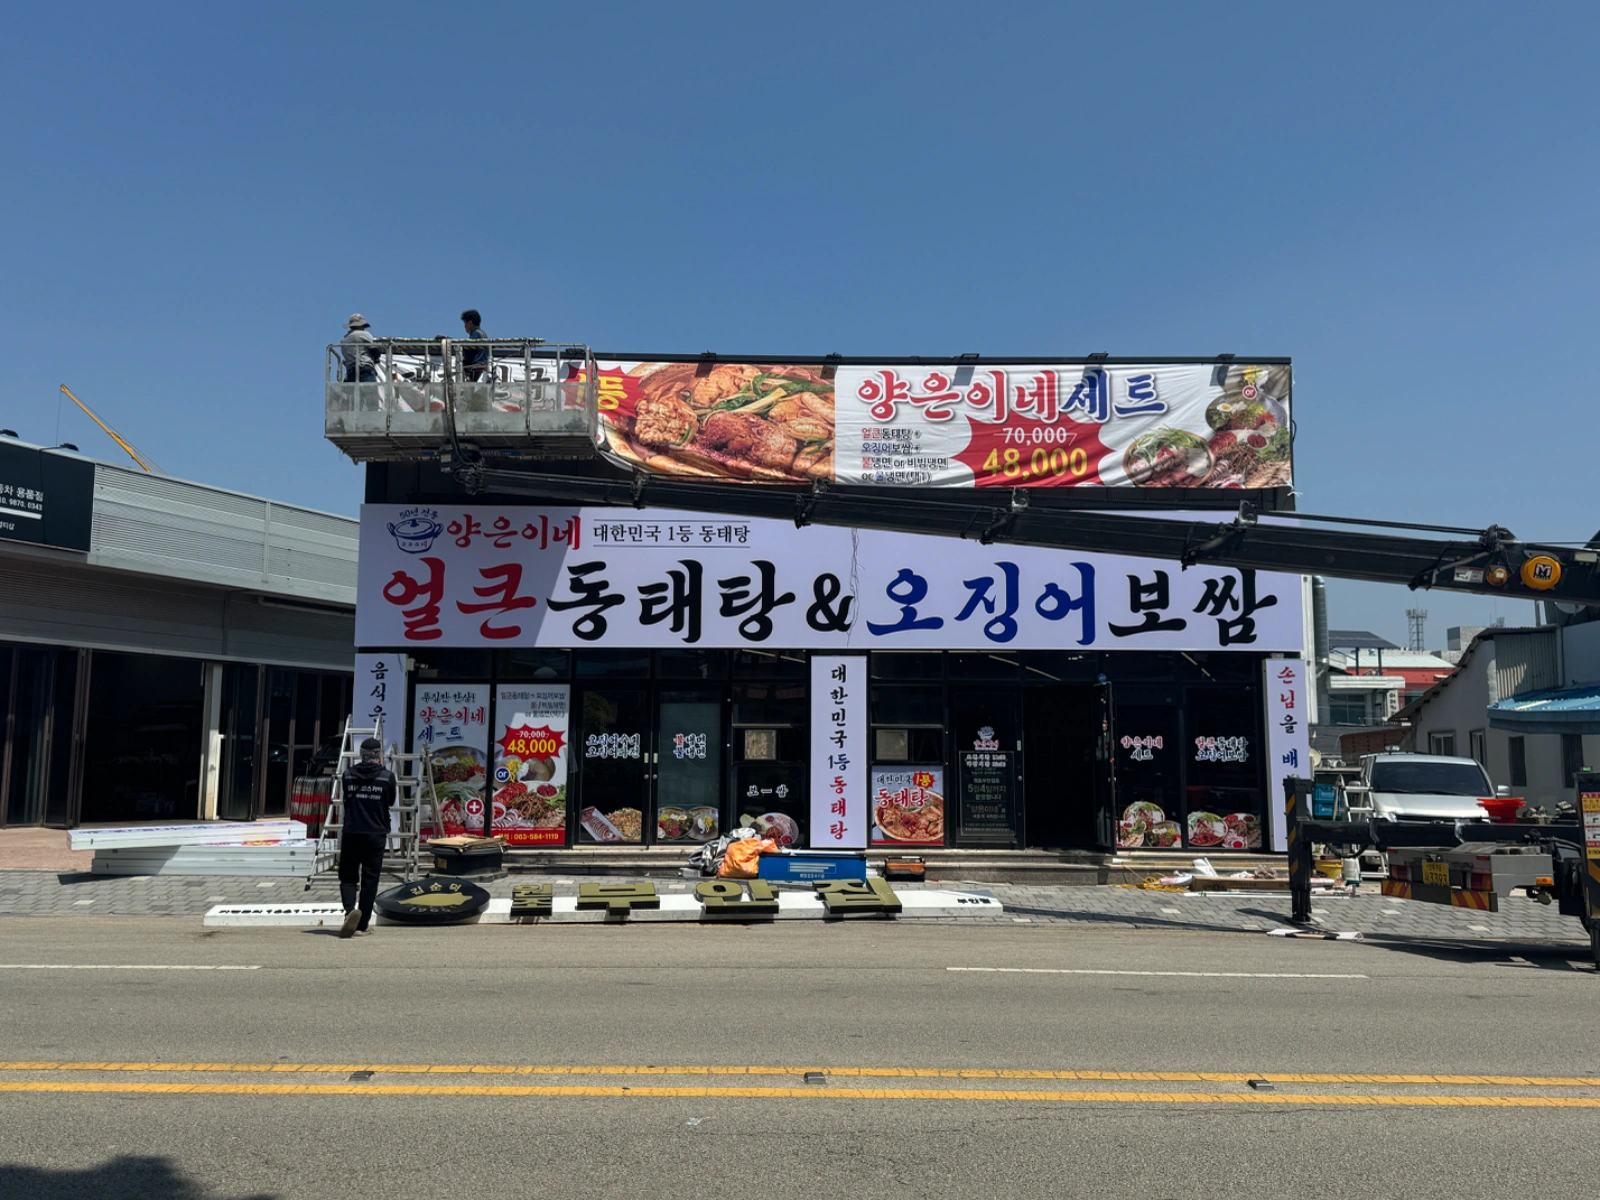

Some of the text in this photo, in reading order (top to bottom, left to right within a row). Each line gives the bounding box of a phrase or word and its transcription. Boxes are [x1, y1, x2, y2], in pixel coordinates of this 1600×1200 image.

[1003, 427, 1067, 445] 70,000
[894, 460, 906, 468] or
[906, 457, 949, 469] 비빔냉면
[983, 448, 1088, 480] 48,000
[399, 507, 419, 520] 50년
[447, 514, 581, 550] 양은이네
[593, 524, 751, 544] 대한민국 1등 동태탕
[1277, 666, 1298, 734] 손님을
[419, 706, 486, 725] 양은이네
[508, 739, 557, 754] 48,000
[1120, 735, 1164, 749] 양은이네
[1195, 736, 1249, 749] 얼큰동태탕
[827, 663, 851, 840] 대한민국 1등 동태탕
[1130, 748, 1154, 761] 세트
[1195, 748, 1249, 762] 오징어보쌈
[497, 770, 509, 779] or
[876, 774, 912, 785] 대한민국
[874, 788, 930, 808] 동태탕
